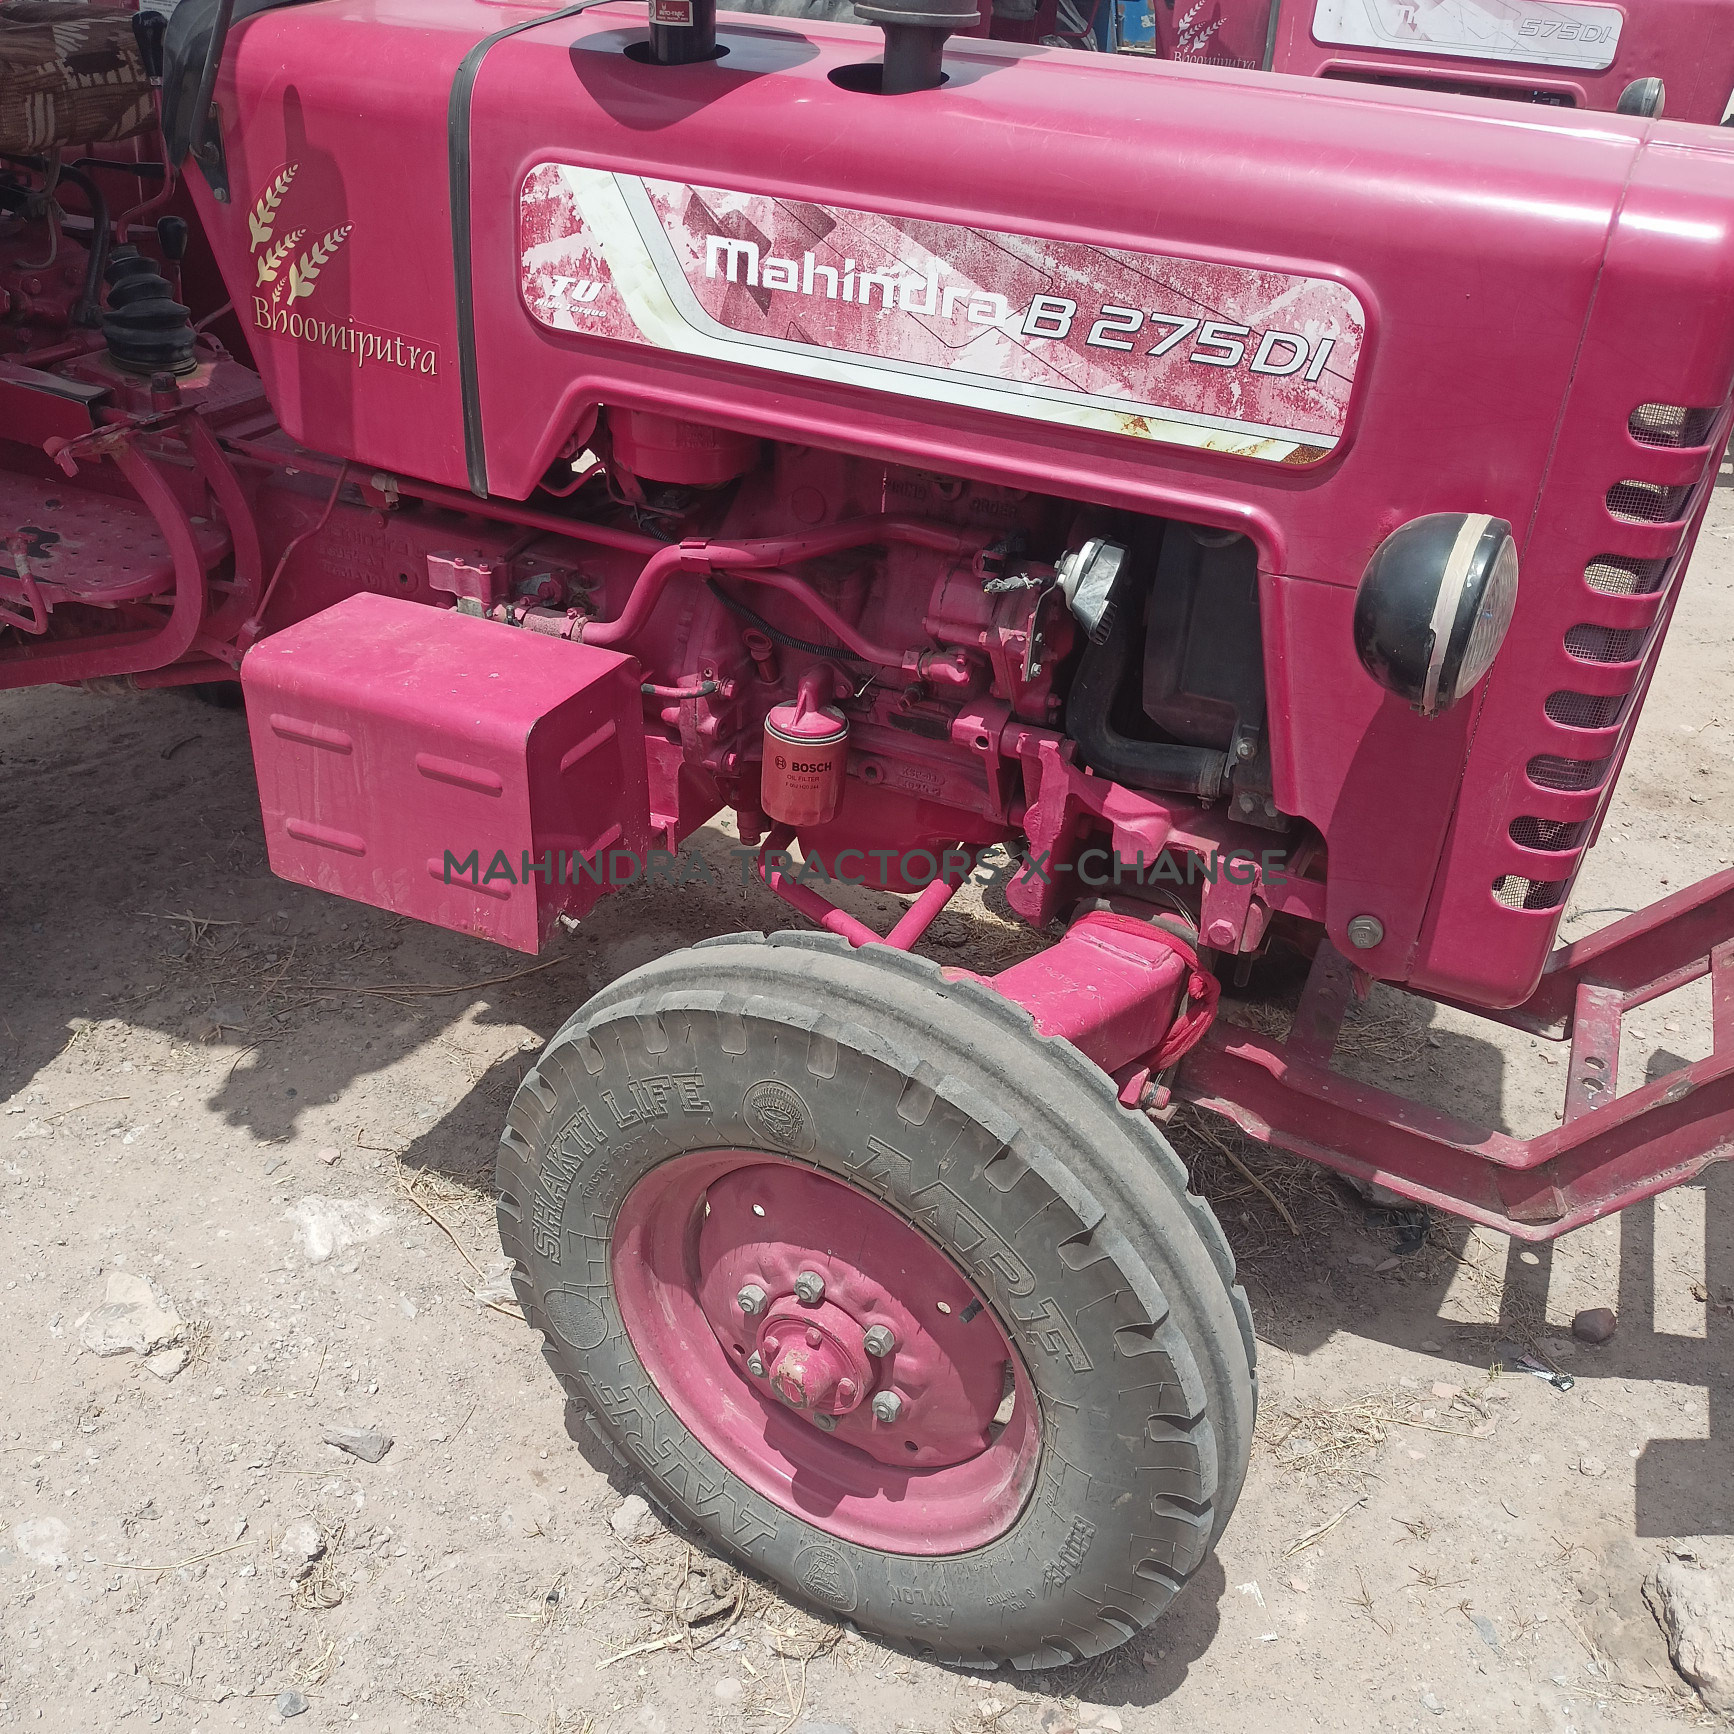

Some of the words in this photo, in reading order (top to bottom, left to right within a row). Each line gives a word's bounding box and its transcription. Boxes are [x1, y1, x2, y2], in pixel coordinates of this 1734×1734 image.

[1518, 17, 1612, 43] 575DI
[549, 274, 605, 303] TU
[566, 304, 608, 318] Torque
[705, 233, 1009, 328] Mahindra
[1020, 293, 1078, 339] B
[1086, 304, 1336, 382] 275DI
[252, 295, 438, 376] Bhoomiputra
[791, 761, 832, 773] BOSCH
[532, 1105, 608, 1265] SHAKTI
[601, 1073, 713, 1128] LIFE
[843, 1134, 1094, 1373] MRF
[579, 1369, 778, 1557] MRF
[889, 1584, 951, 1607] NYLON
